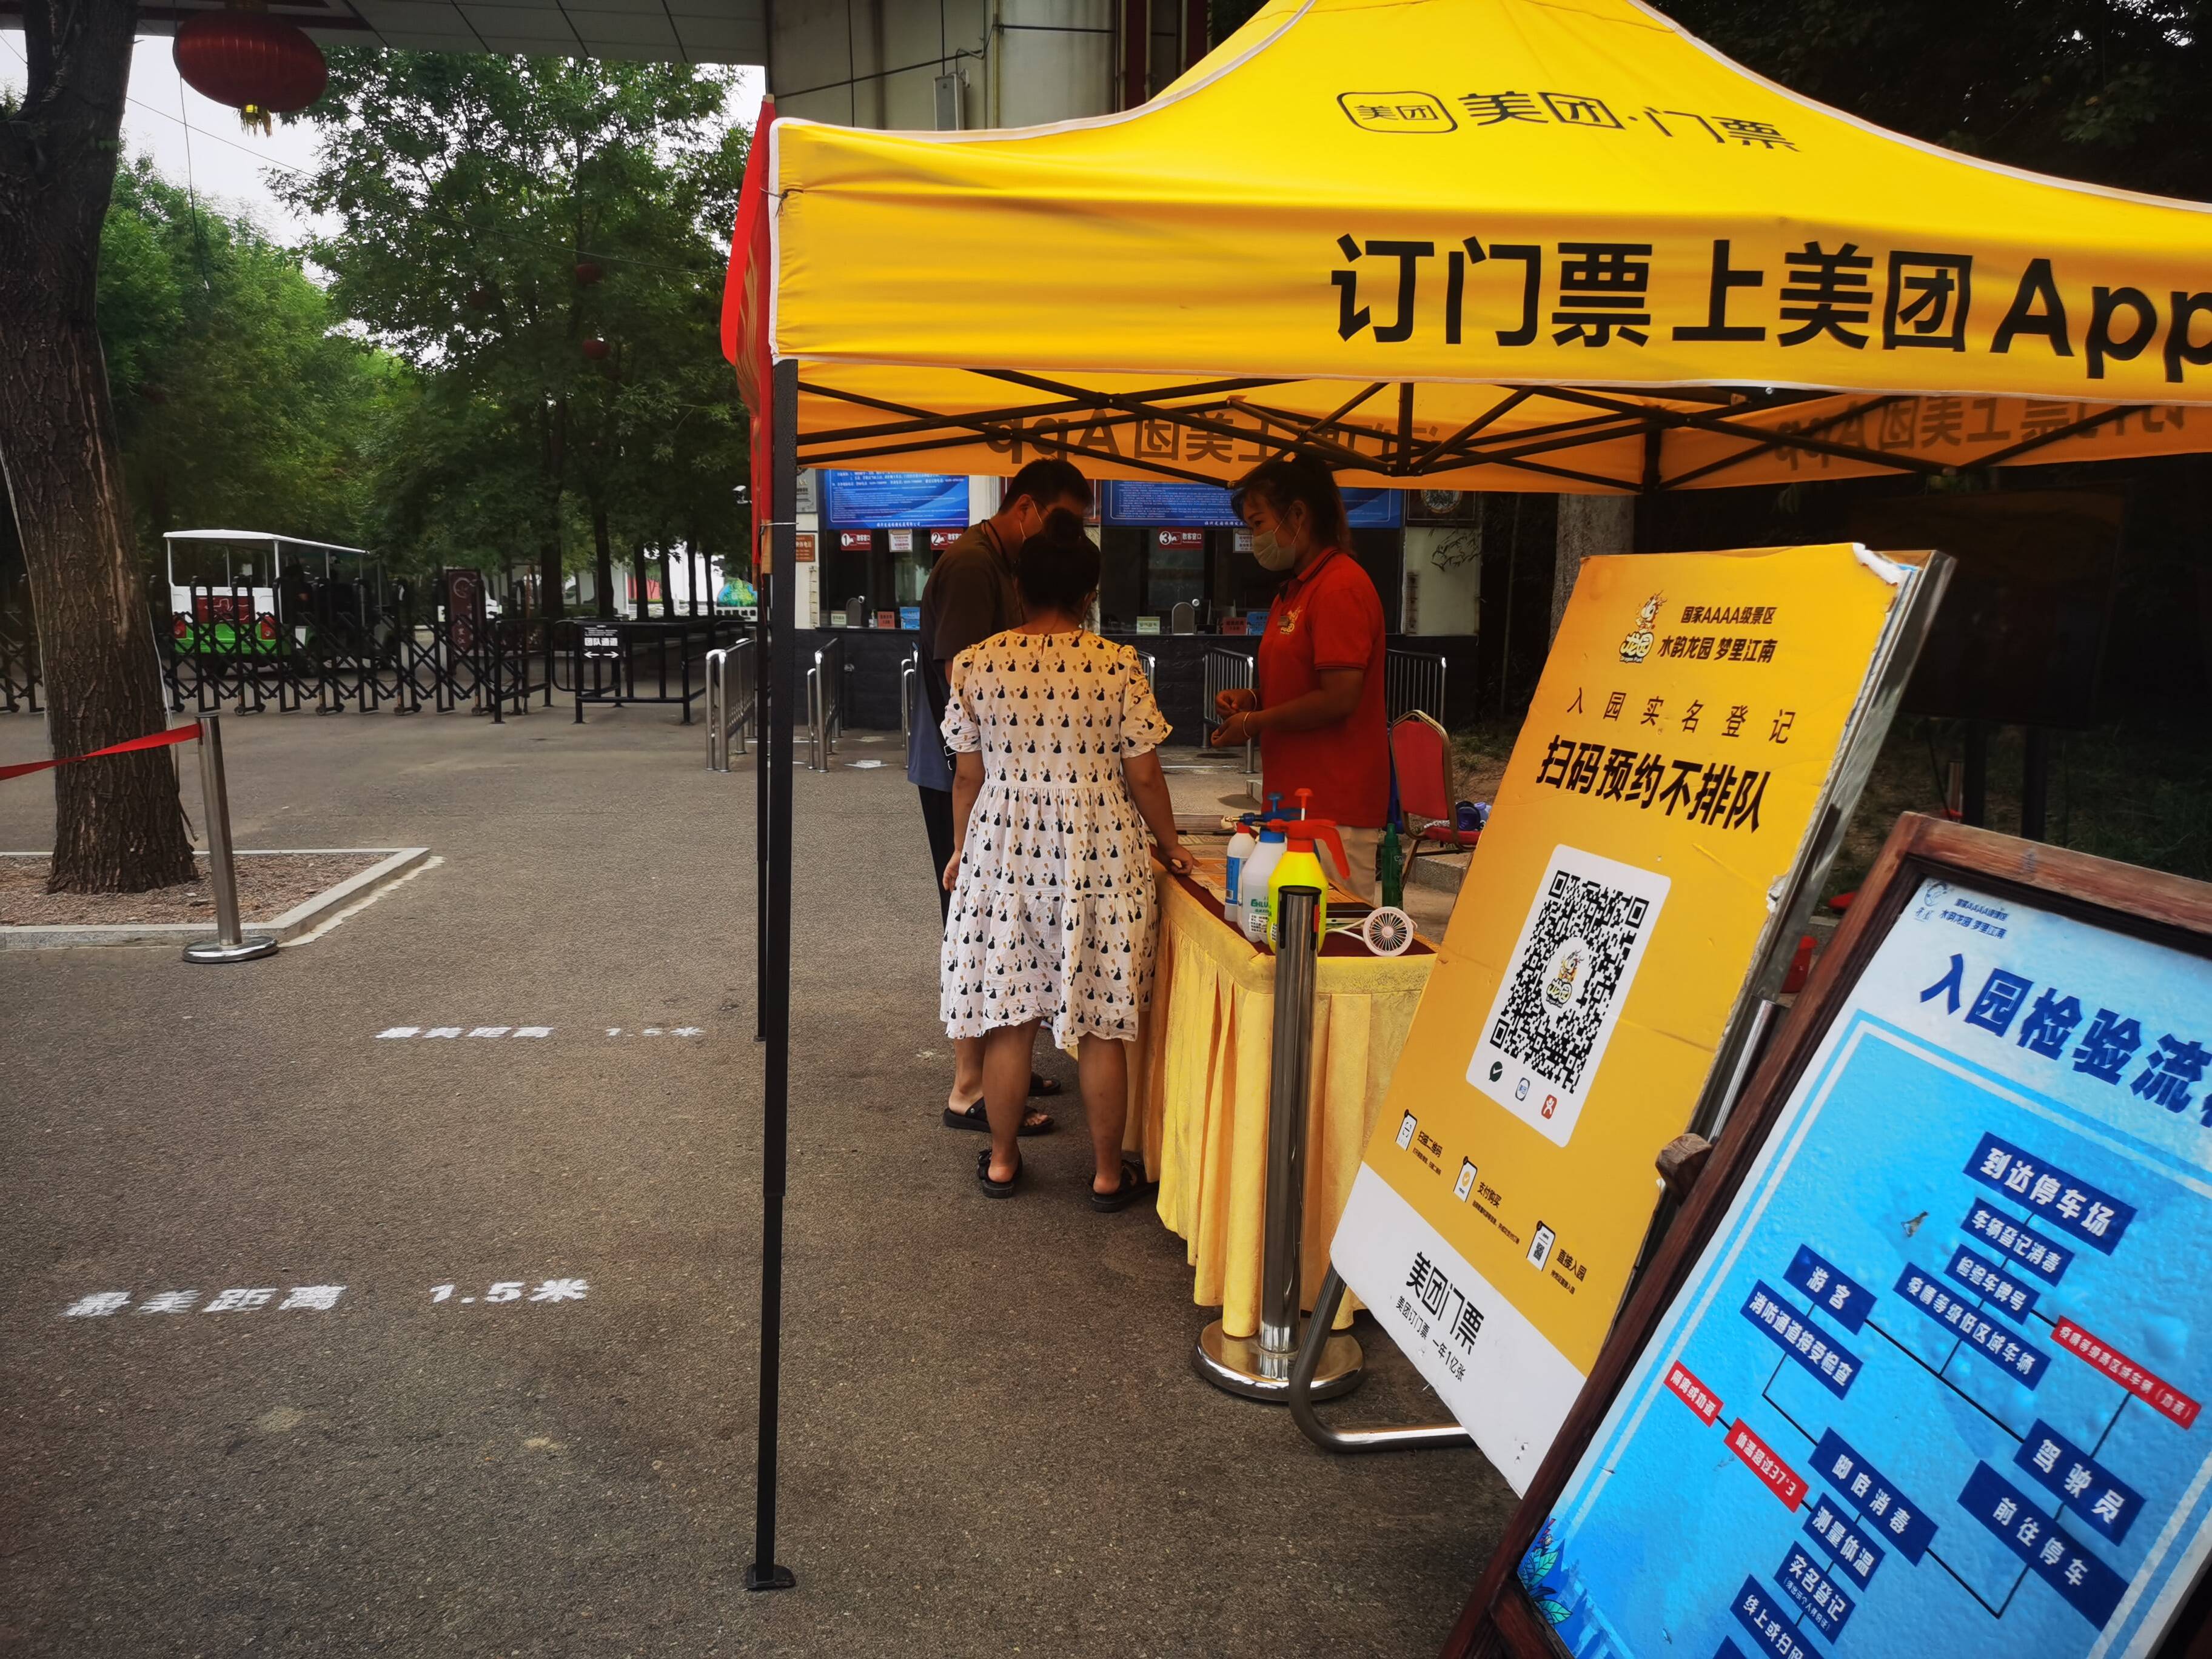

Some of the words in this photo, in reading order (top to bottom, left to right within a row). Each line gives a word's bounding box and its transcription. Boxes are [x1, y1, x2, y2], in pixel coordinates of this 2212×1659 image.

[1354, 102, 1437, 122] 美团
[1330, 233, 1972, 353] 订门票上美团
[1989, 257, 2212, 384] App
[1620, 631, 1654, 658] 龙园
[1680, 606, 1778, 625] 国家AAAA级景区
[1657, 635, 1715, 660] 水韵龙园
[1714, 637, 1778, 664] 梦里江南
[1566, 686, 1797, 745] 入园实名登记
[1535, 734, 1772, 834] 扫码预约不排队
[1477, 1181, 1503, 1208] 支付购买
[1979, 1147, 2117, 1239] 到达停车场
[1556, 1248, 1587, 1282] 直接入园
[1970, 1210, 2063, 1275] 车辆登记消毒
[428, 1278, 591, 1304] 1.5米
[1406, 1250, 1485, 1356] 美团门票
[1806, 1265, 1852, 1310] 游客
[1954, 1255, 2028, 1312] 检验车牌号
[1395, 1295, 1430, 1341] 美团订门票
[1431, 1339, 1467, 1383] 一年1亿张
[1748, 1293, 1854, 1389] 消防通道接受检查
[1906, 1276, 2038, 1377] 疫情等级低区域车辆
[1668, 1369, 1717, 1419] 隔离或劝返
[1831, 1453, 1912, 1535] 脚底消毒
[2031, 1438, 2127, 1526] 驾驶员
[1811, 1505, 1877, 1578] 测量体温
[1991, 1496, 2090, 1587] 前往停车
[1788, 1553, 1849, 1622] 实名登记
